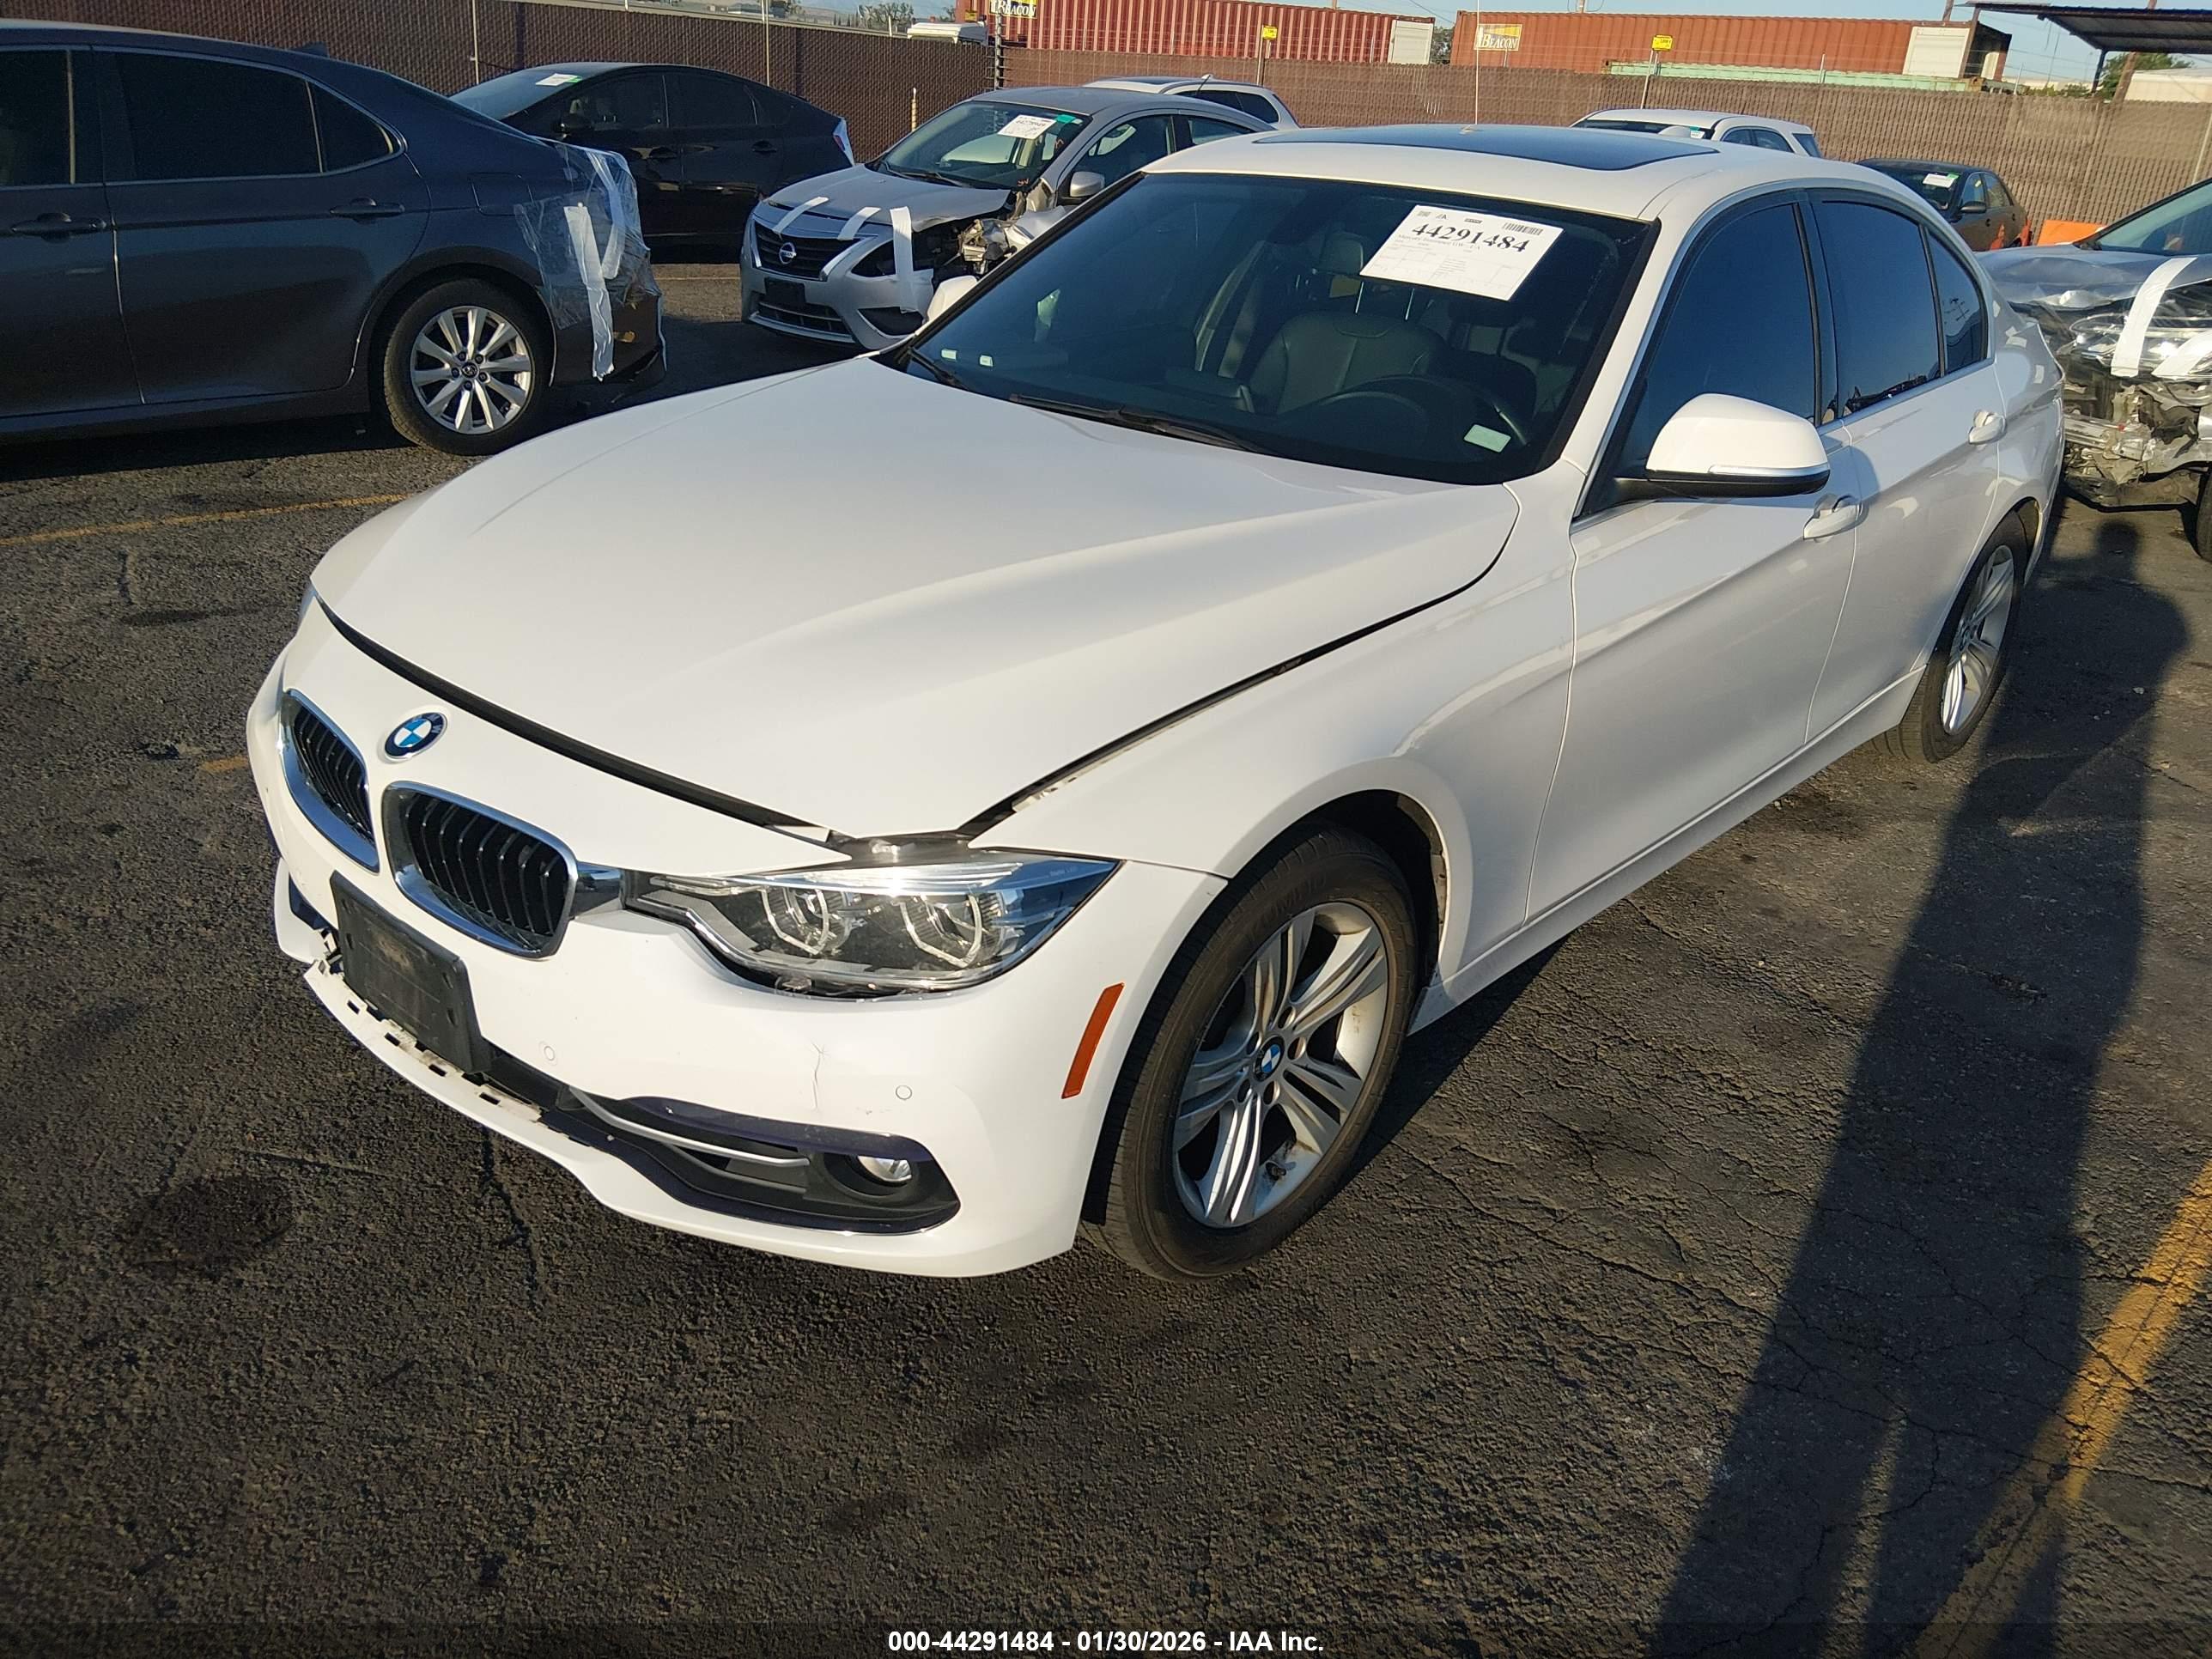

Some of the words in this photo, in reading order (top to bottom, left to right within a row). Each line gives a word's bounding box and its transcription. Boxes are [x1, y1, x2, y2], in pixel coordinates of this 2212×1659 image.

[998, 0, 1036, 17] BEACON
[1481, 33, 1518, 49] BEACON
[1412, 223, 1530, 252] 44291484
